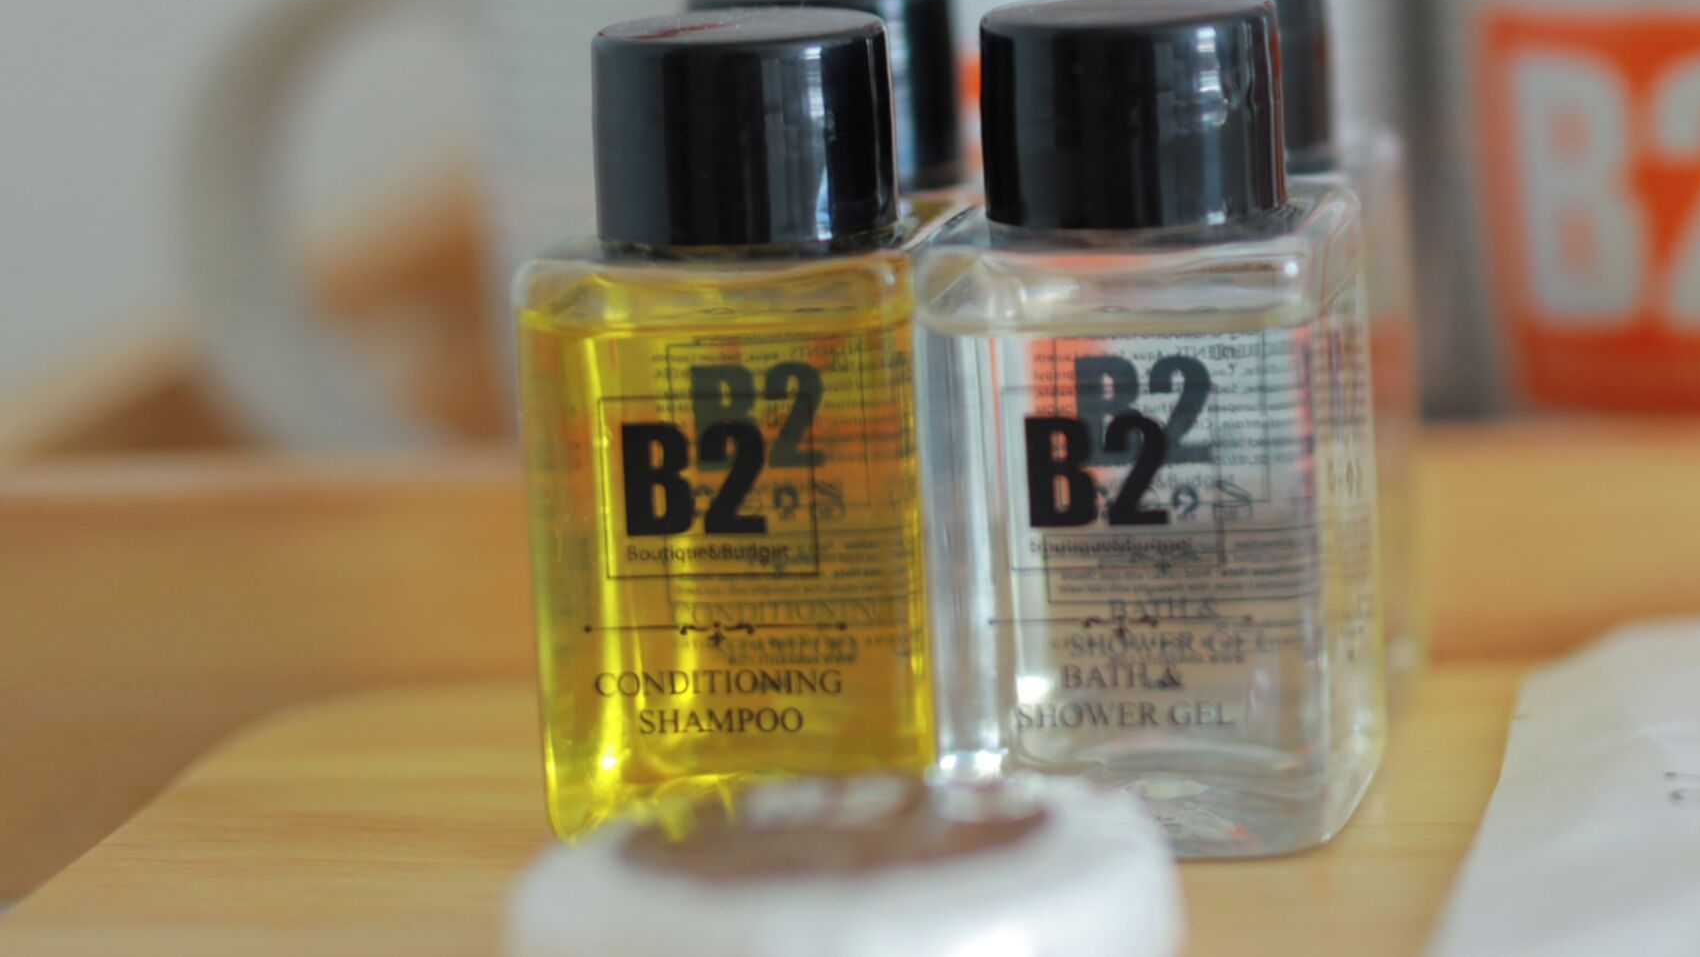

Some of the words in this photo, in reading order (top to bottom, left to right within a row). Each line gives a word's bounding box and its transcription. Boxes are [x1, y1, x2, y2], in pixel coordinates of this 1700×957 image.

[691, 361, 825, 472] B2
[1074, 355, 1213, 466] B2
[621, 422, 769, 536] B2
[1024, 409, 1169, 527] B2
[595, 668, 843, 696] CONDITIONING
[1061, 663, 1149, 689] BATH
[639, 707, 804, 735] SHAMPOO
[1015, 700, 1160, 729] SHOWER
[1168, 700, 1236, 729] GEL
